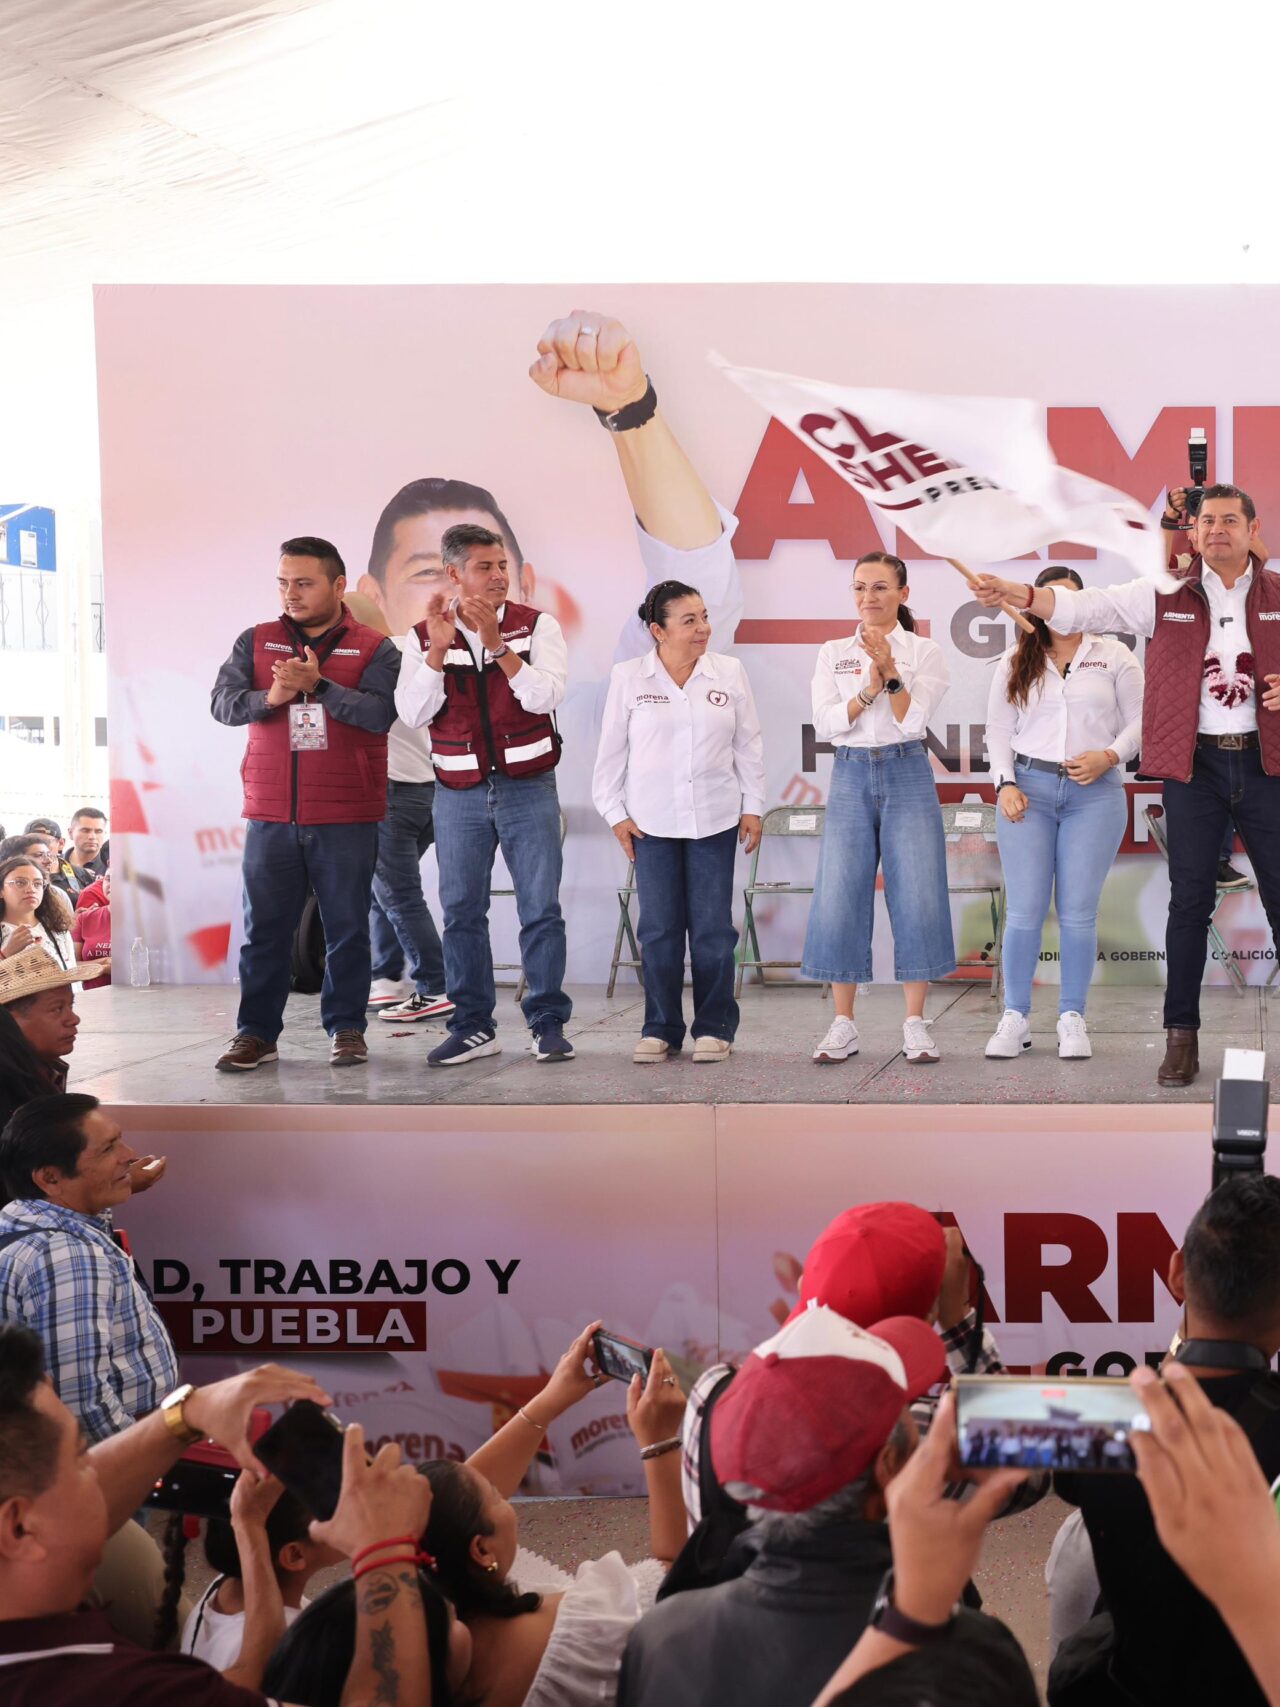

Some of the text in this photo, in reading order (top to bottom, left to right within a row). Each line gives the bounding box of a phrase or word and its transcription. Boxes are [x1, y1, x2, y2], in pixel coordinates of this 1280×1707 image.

[1163, 611, 1195, 620] ARMENTA
[219, 1259, 470, 1295] TRABAJO
[485, 1259, 521, 1295] Y
[192, 1308, 415, 1344] PUEBLA
